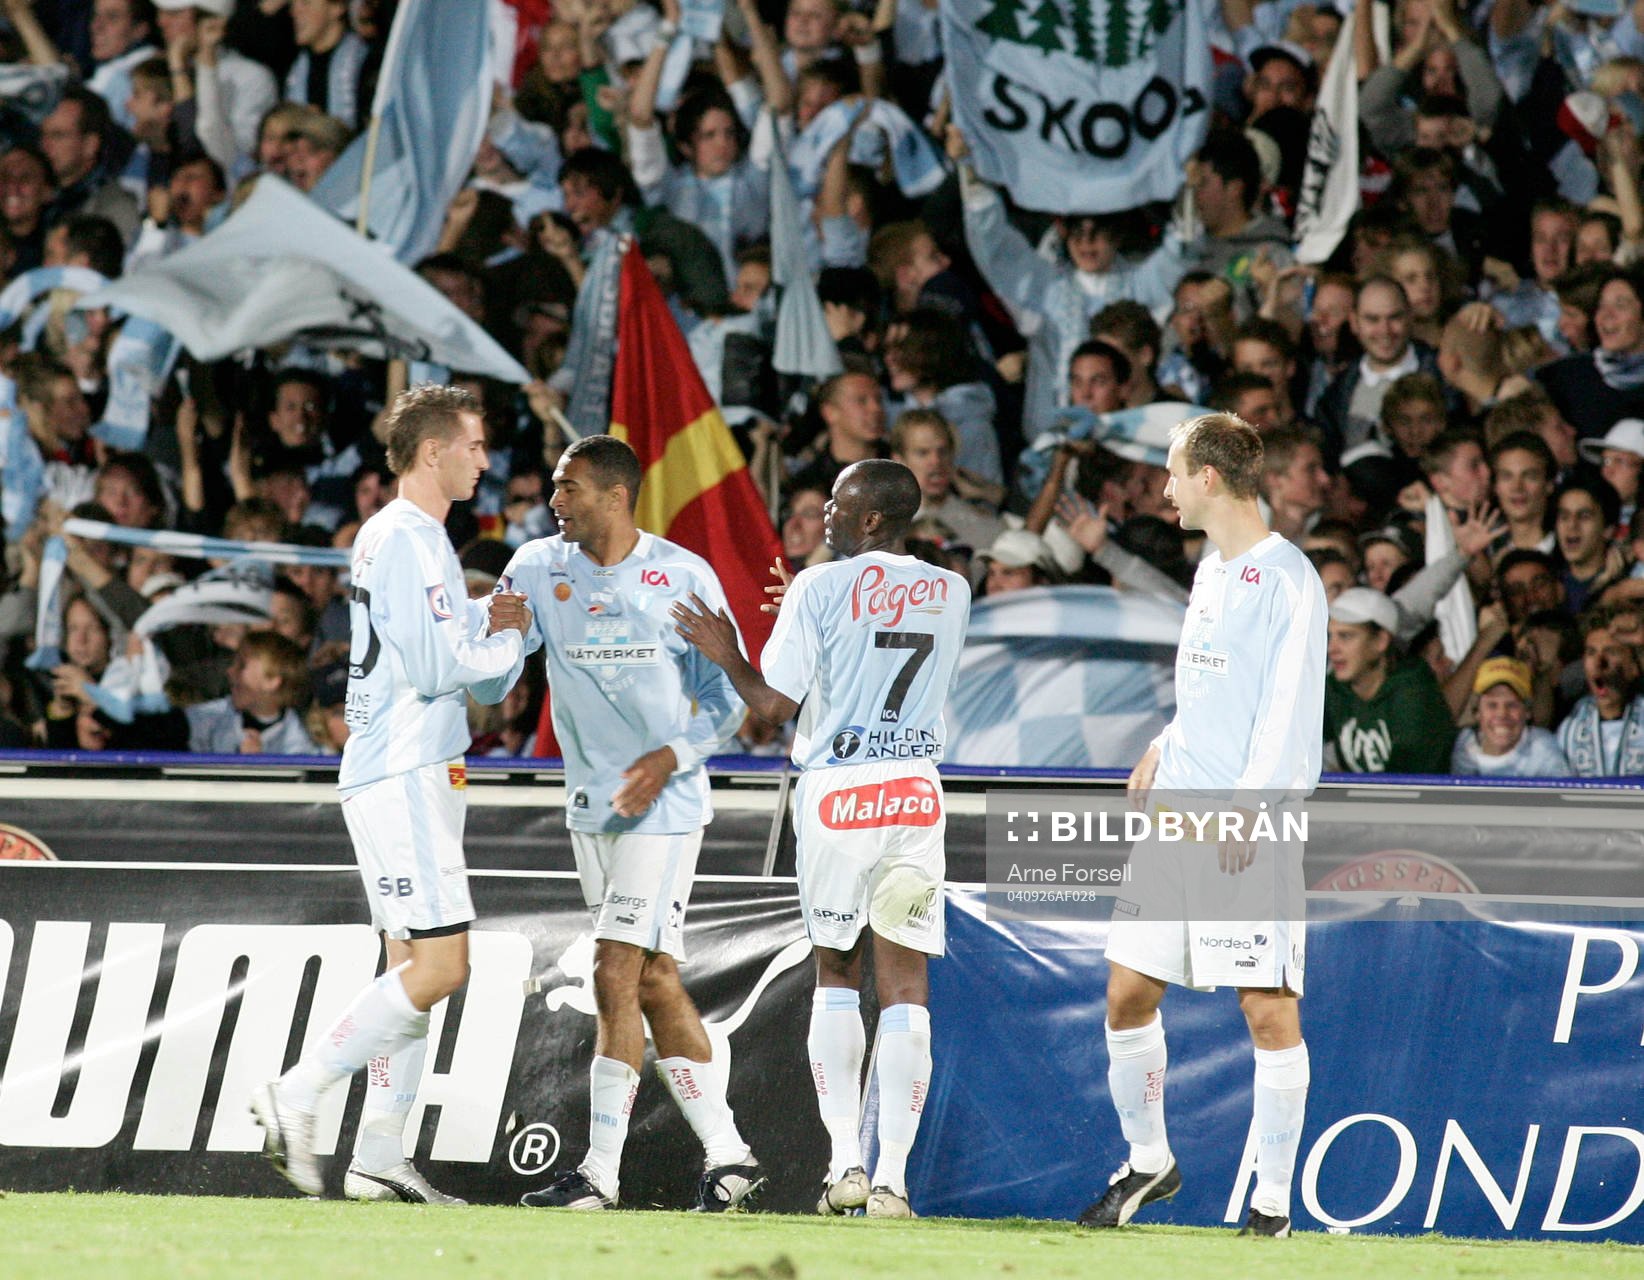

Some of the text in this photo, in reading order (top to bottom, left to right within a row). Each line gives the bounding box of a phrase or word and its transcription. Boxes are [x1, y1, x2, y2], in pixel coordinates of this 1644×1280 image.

[641, 569, 670, 587] ICA
[1240, 565, 1261, 585] ICA
[851, 565, 948, 628] Pågen
[874, 631, 934, 722] 7
[882, 709, 899, 720] ICA
[868, 727, 936, 744] HILDIN
[831, 789, 934, 824] Malaco
[1199, 934, 1252, 950] Nordea
[1553, 929, 1644, 1046] P
[0, 919, 533, 1163] UMA
